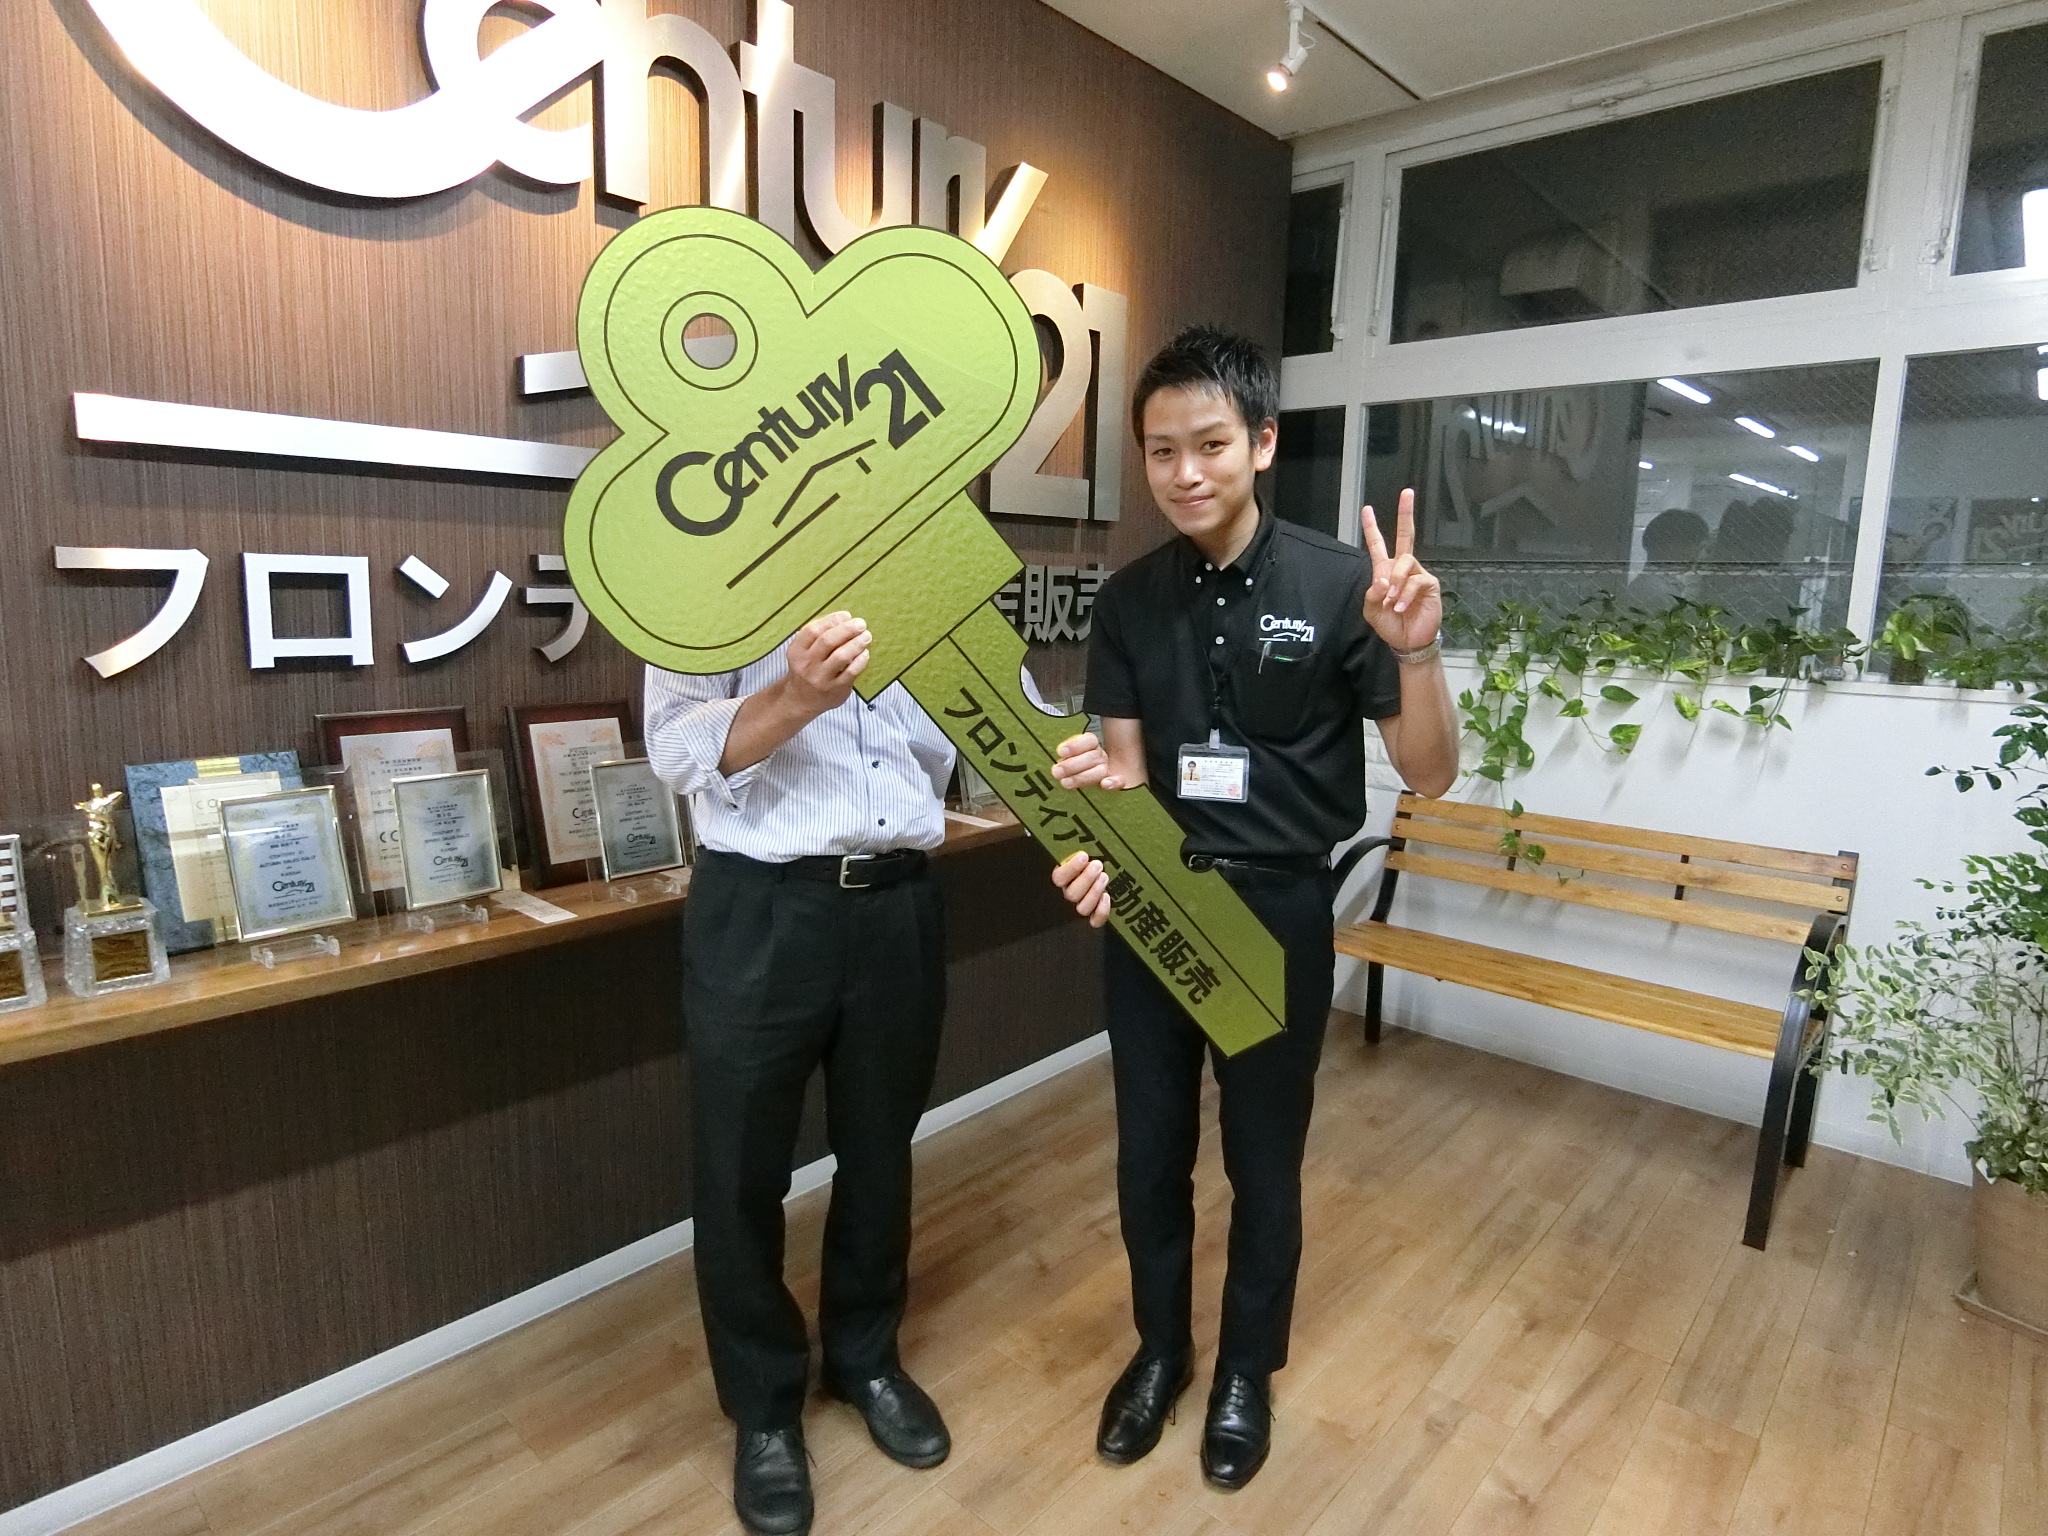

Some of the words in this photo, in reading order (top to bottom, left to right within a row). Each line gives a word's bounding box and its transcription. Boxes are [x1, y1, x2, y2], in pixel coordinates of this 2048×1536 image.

[655, 352, 854, 537] Century
[853, 347, 946, 451] 21
[989, 268, 1128, 522] 21
[1260, 614, 1307, 631] Century
[1300, 625, 1315, 642] 21
[272, 879, 307, 892] Century
[305, 882, 315, 893] 21
